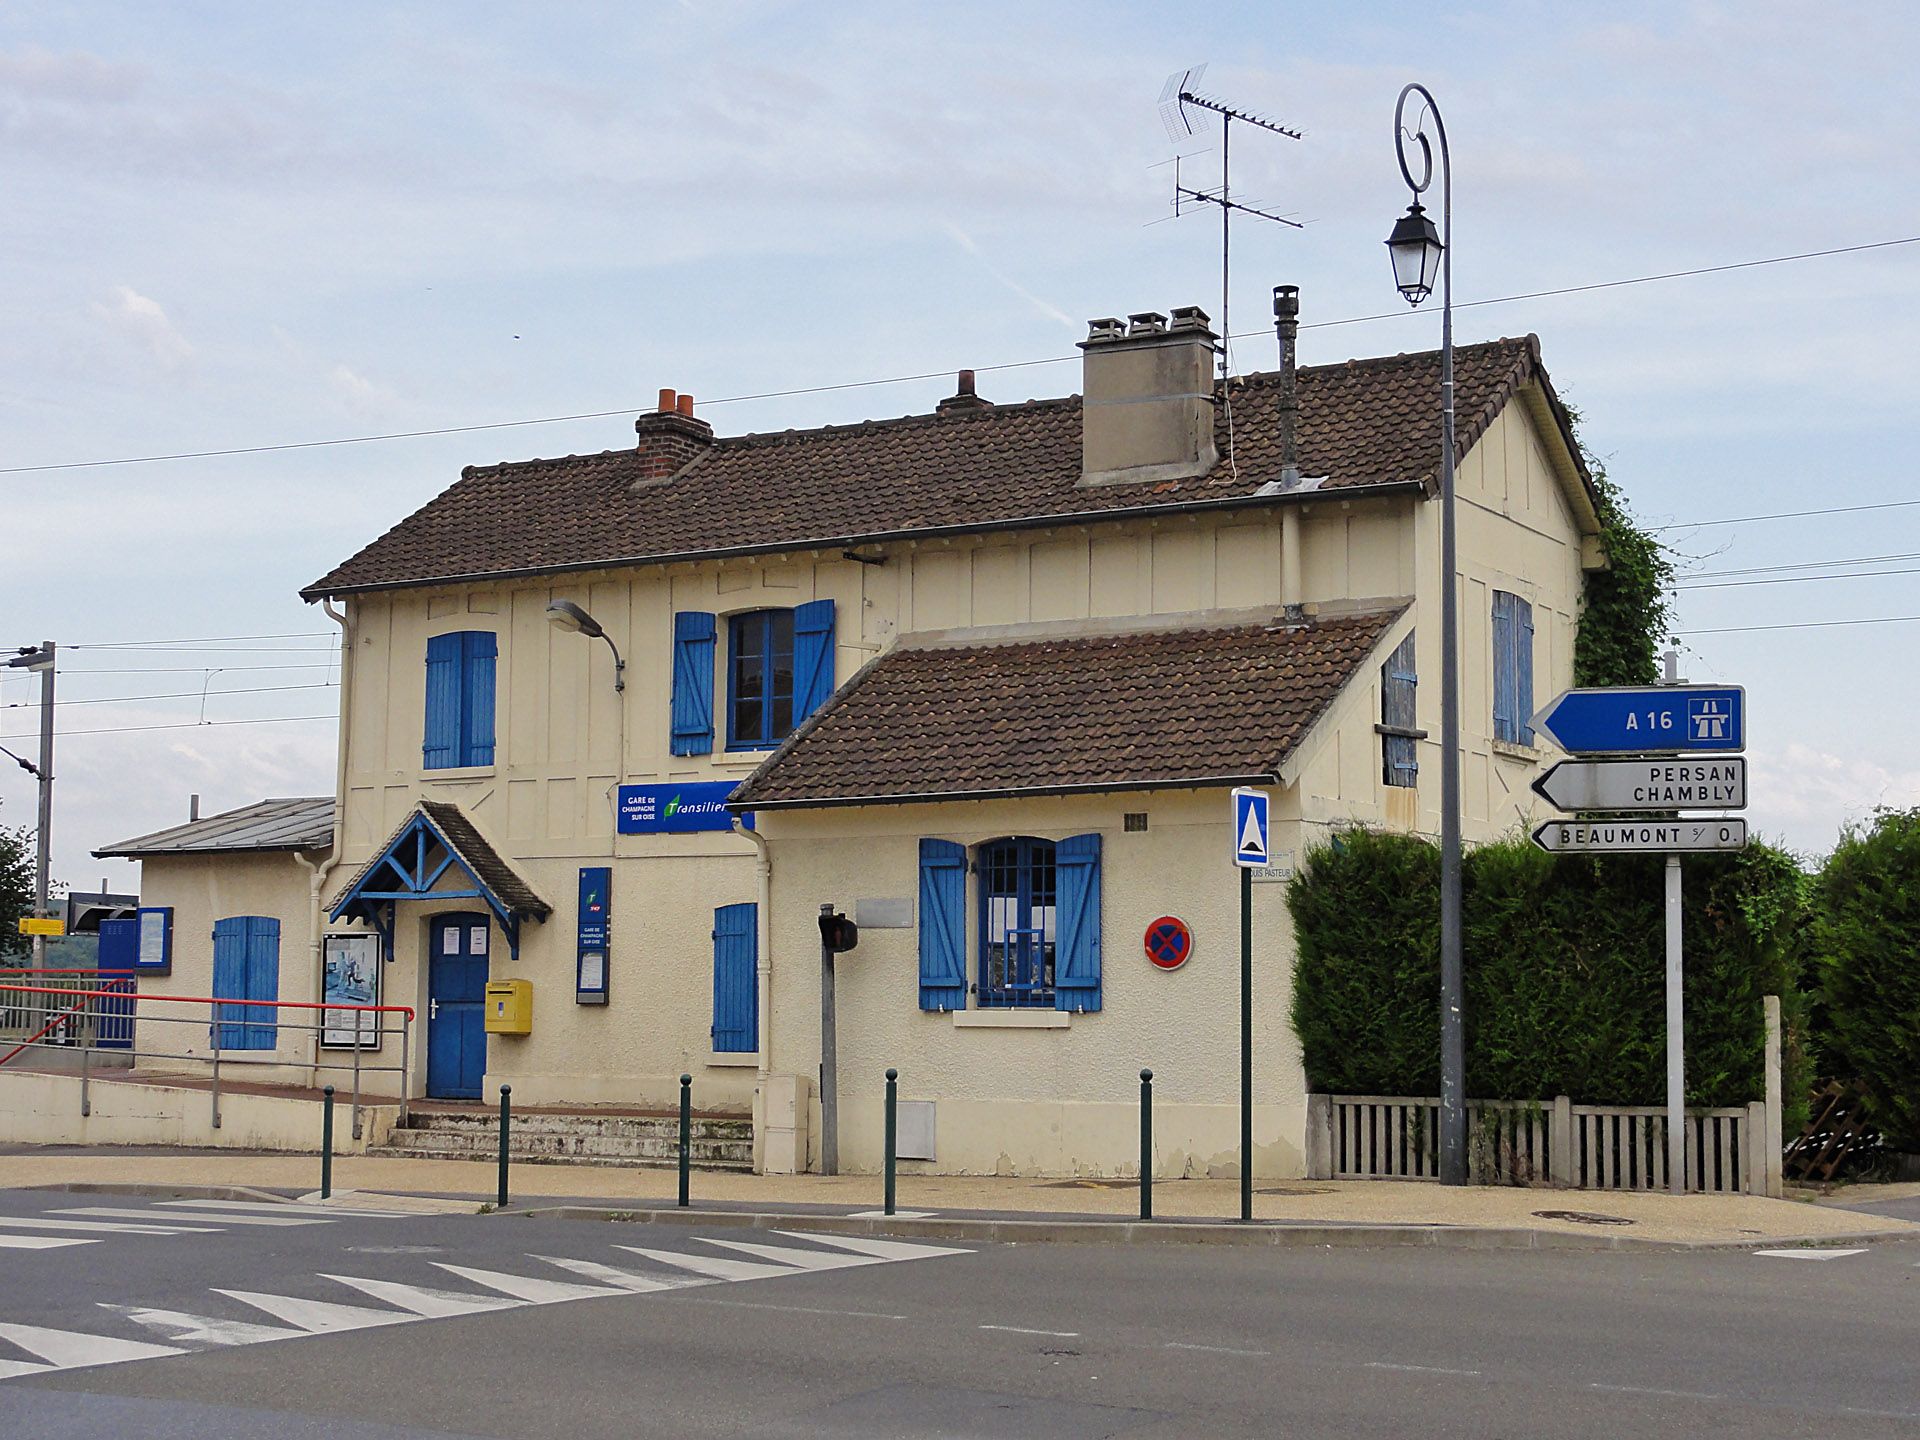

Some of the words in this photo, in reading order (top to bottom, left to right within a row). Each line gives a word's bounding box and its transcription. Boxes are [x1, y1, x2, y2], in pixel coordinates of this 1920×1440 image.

[1626, 712, 1638, 730] A
[1647, 711, 1673, 729] 16
[1650, 767, 1736, 782] PERSAN
[1634, 786, 1735, 801] CHAMBLY
[1560, 828, 1680, 844] BEAUMONT
[1265, 868, 1290, 877] PASTEUR
